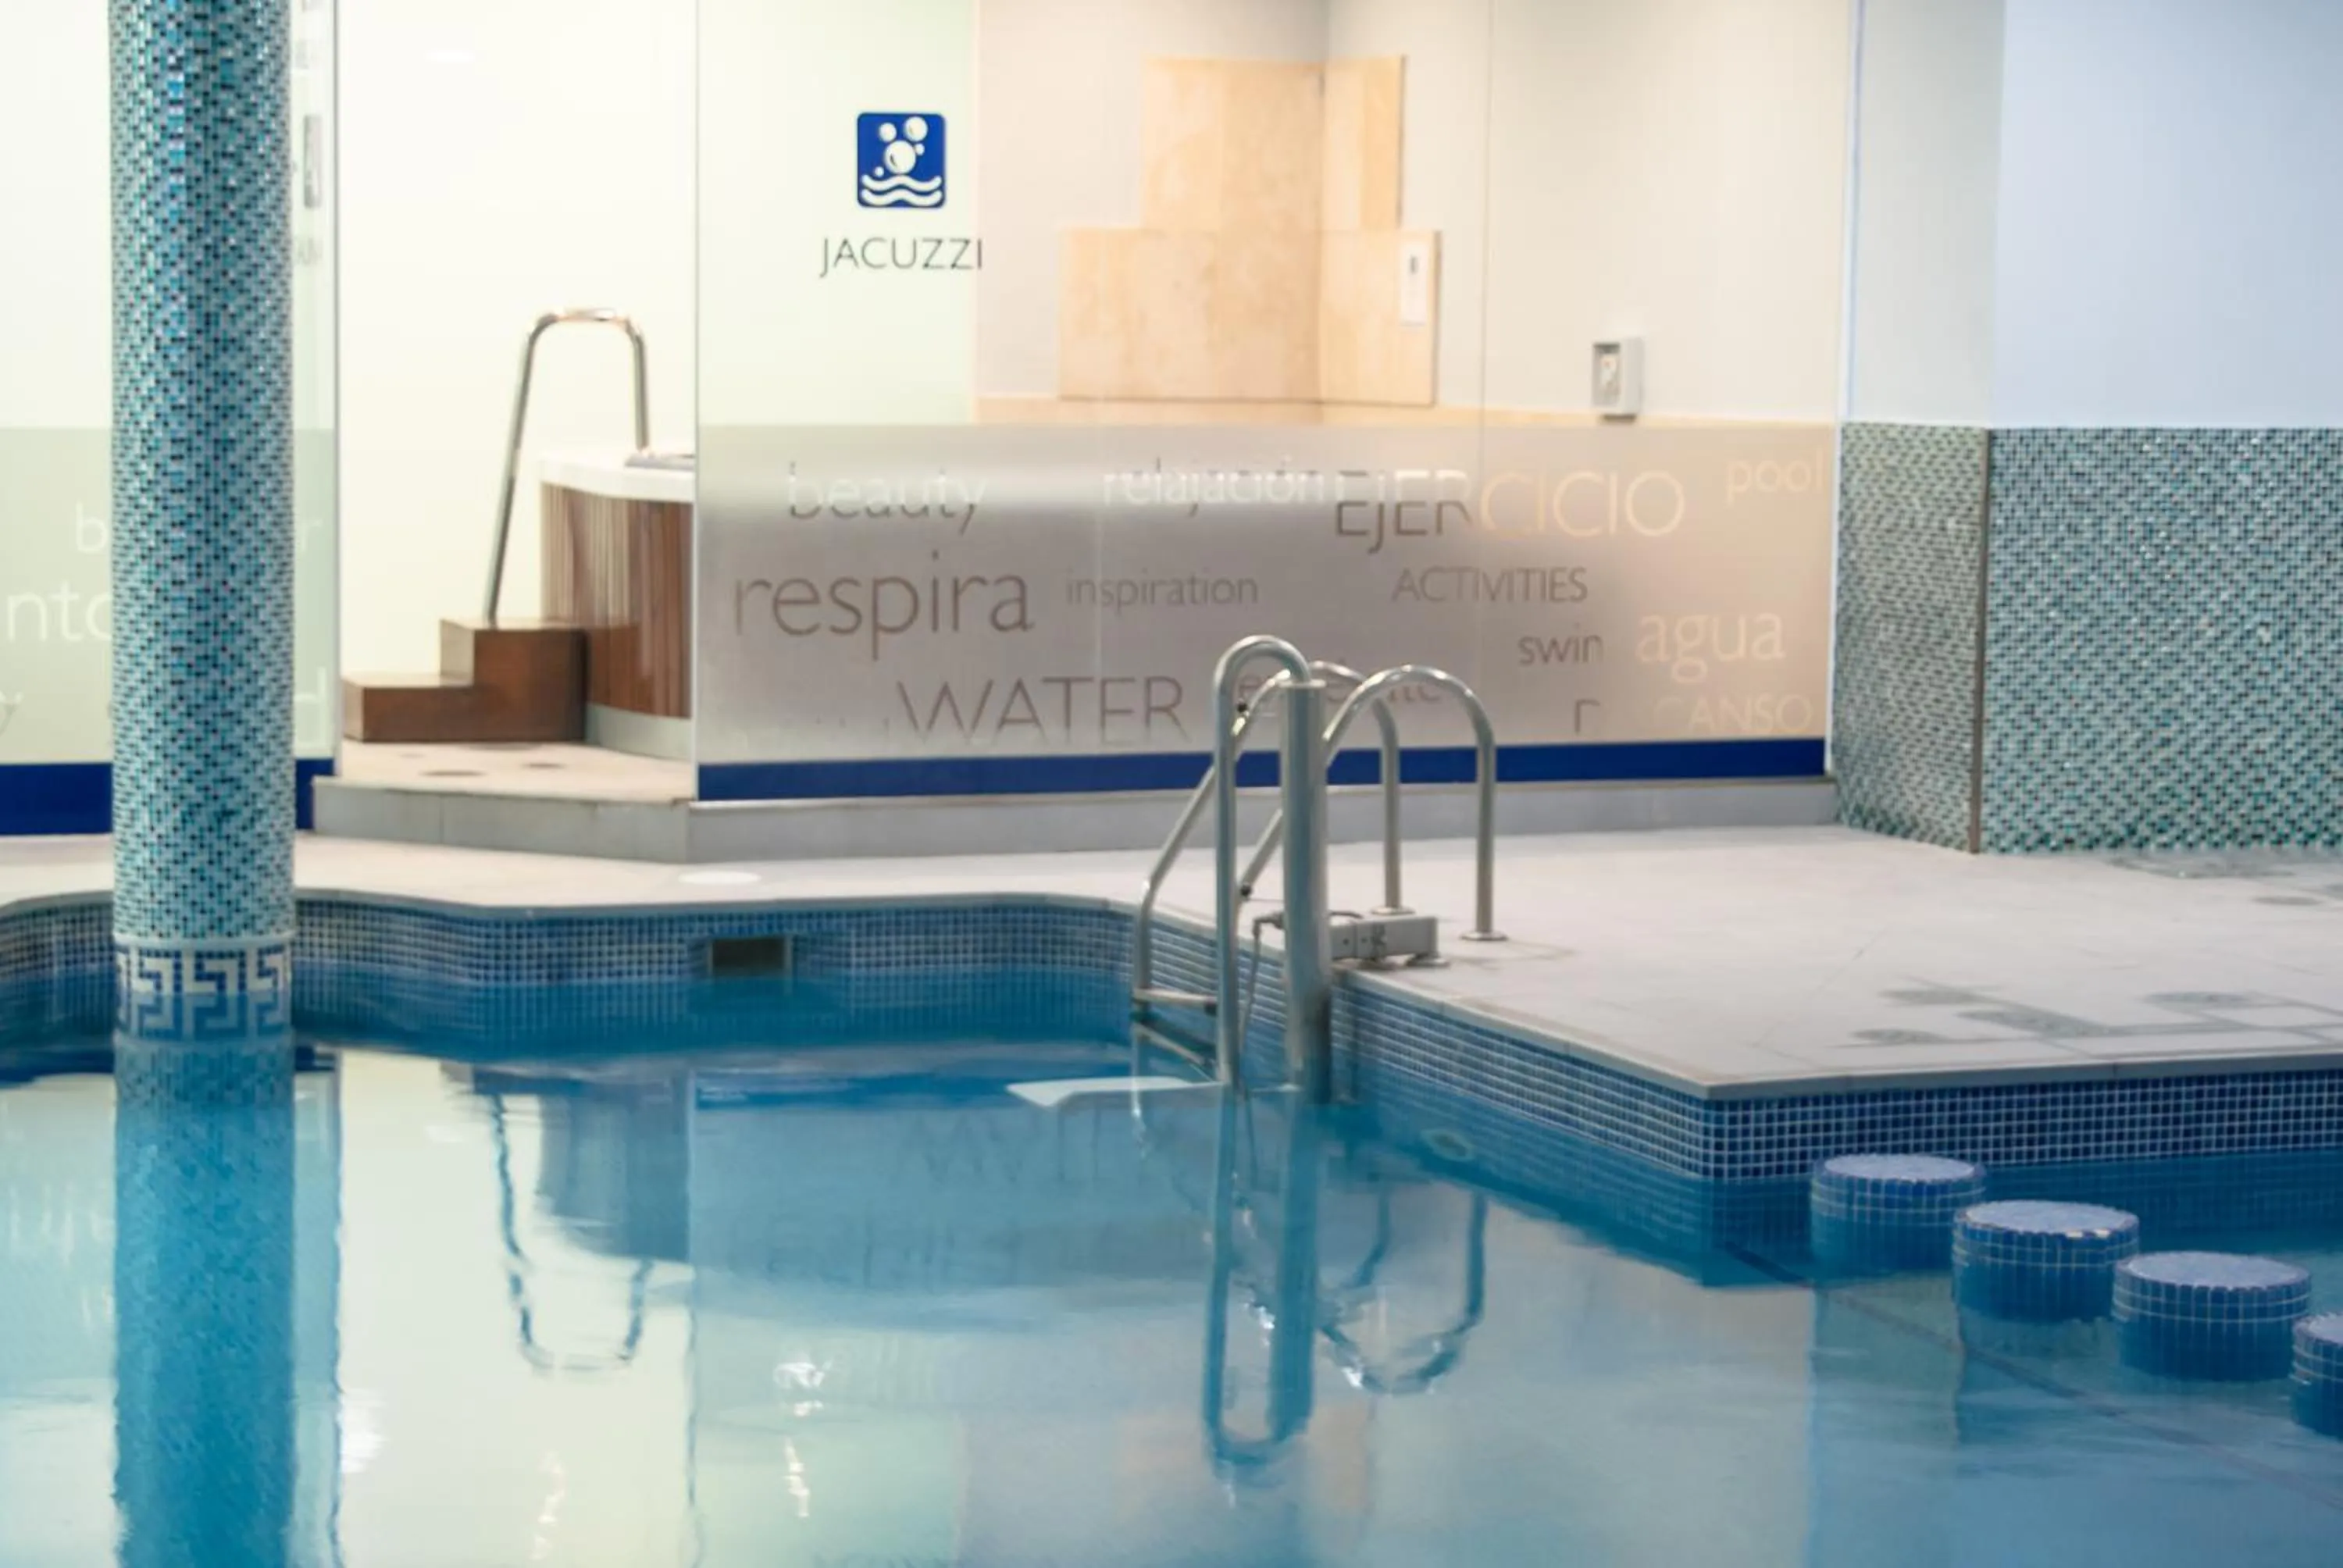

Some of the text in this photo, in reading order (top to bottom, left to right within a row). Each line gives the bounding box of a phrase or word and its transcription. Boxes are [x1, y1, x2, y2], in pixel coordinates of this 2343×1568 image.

[820, 237, 983, 279] JACUZZI
[788, 461, 987, 535] beauty
[1727, 450, 1826, 506] pool
[733, 550, 1035, 661] respira
[1066, 569, 1260, 615] inspiration
[1391, 567, 1590, 604] ACTIVITIES
[1635, 612, 1786, 685] agua
[896, 675, 1192, 747] WATER
